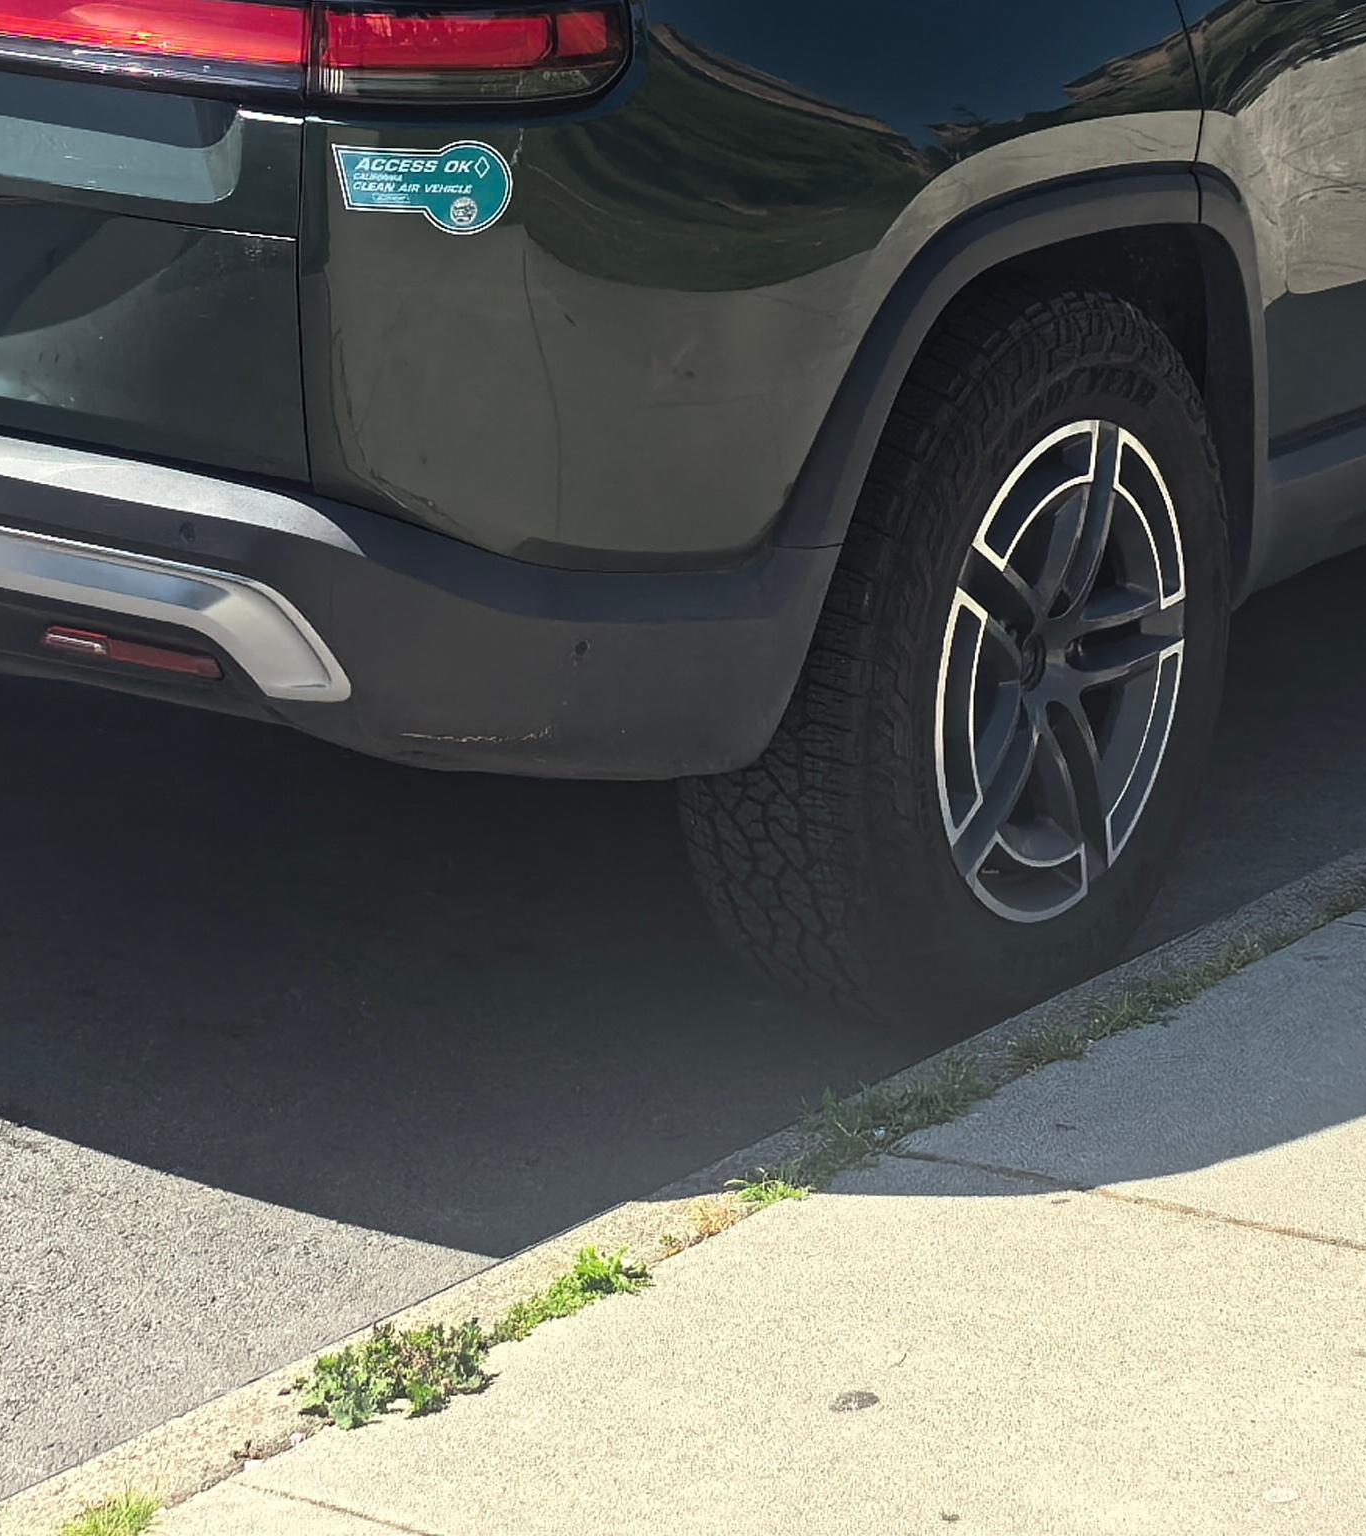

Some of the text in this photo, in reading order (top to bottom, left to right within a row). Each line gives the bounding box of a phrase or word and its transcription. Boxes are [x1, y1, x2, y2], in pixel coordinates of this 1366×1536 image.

[354, 157, 476, 173] ACCESS OK
[353, 172, 404, 182] CALIFORNIA
[353, 181, 474, 195] CLEAN AIR VEHICLE
